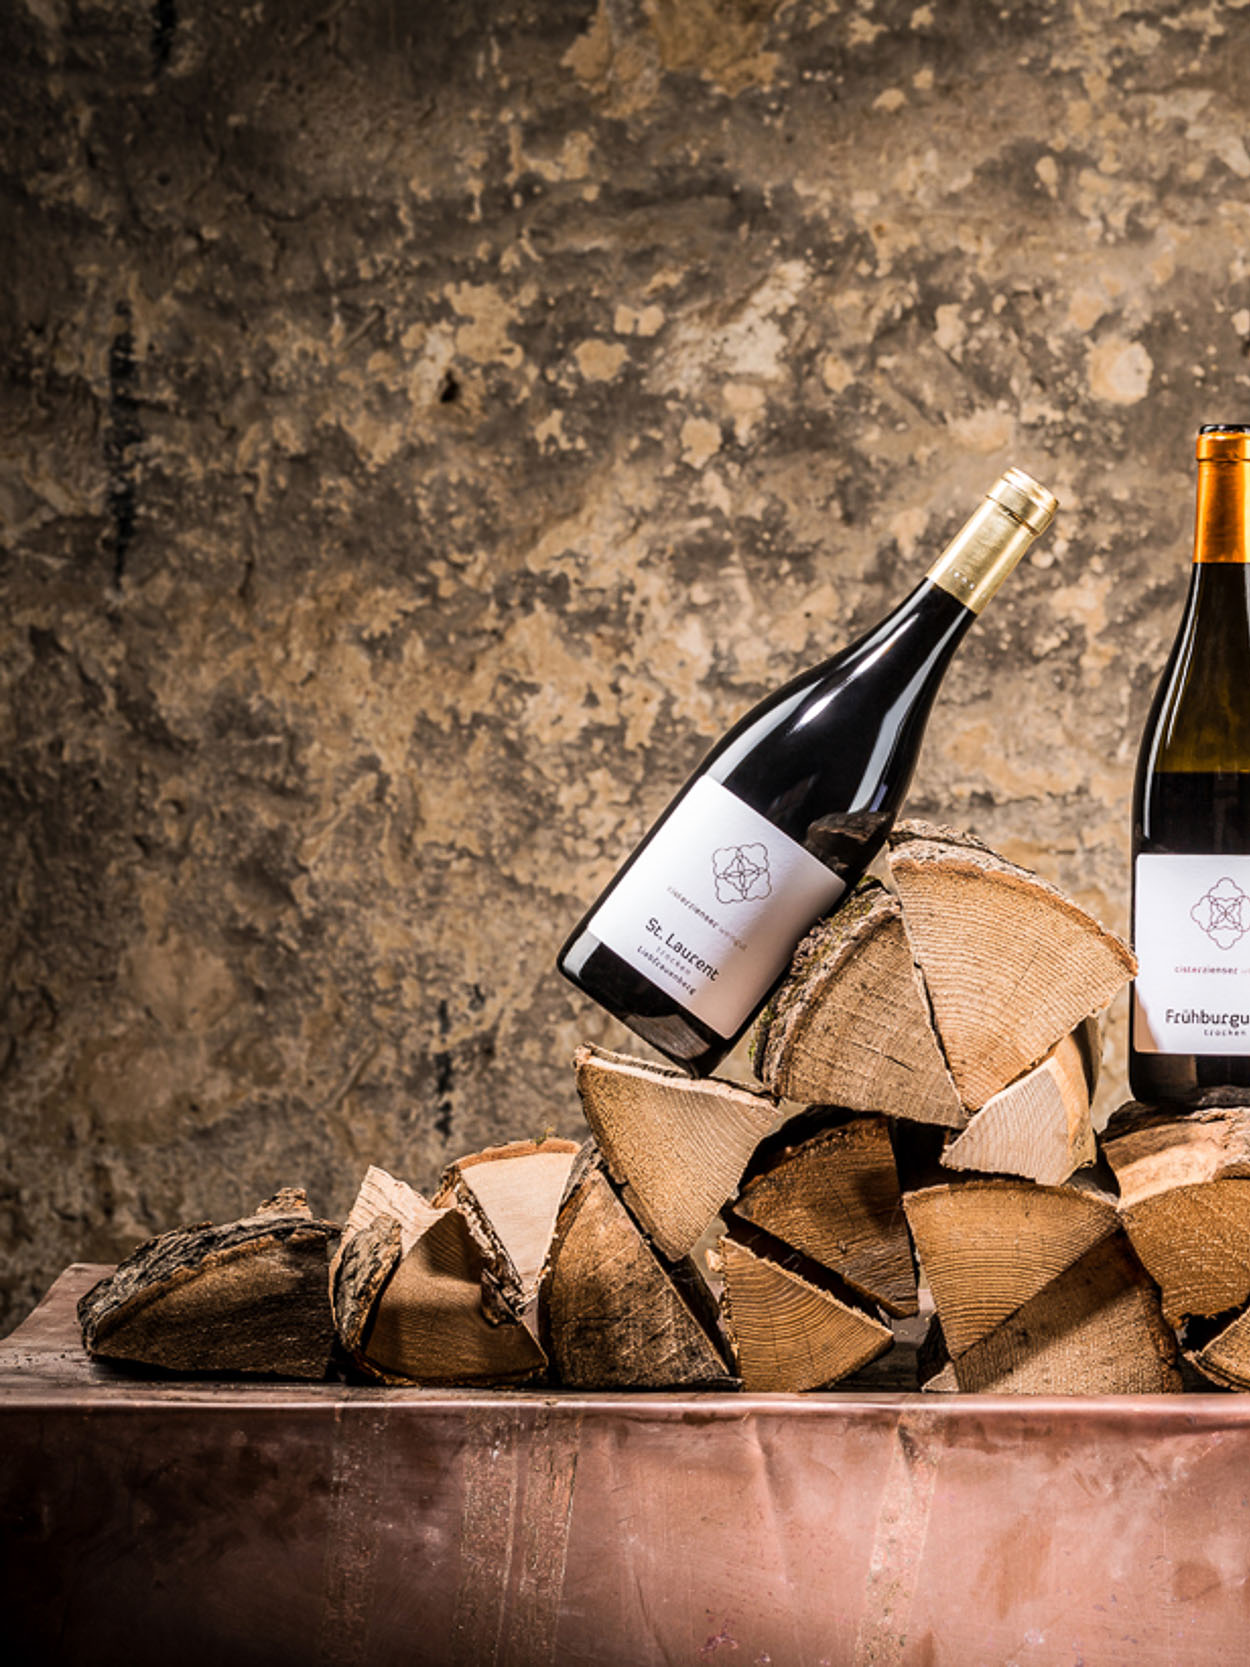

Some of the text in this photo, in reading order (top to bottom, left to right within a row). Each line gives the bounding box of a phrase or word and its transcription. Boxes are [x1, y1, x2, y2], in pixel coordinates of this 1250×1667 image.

[637, 945, 697, 995] Liebfrauenberg
[645, 916, 720, 982] St. Laurent
[1203, 1029, 1247, 1037] trocken
